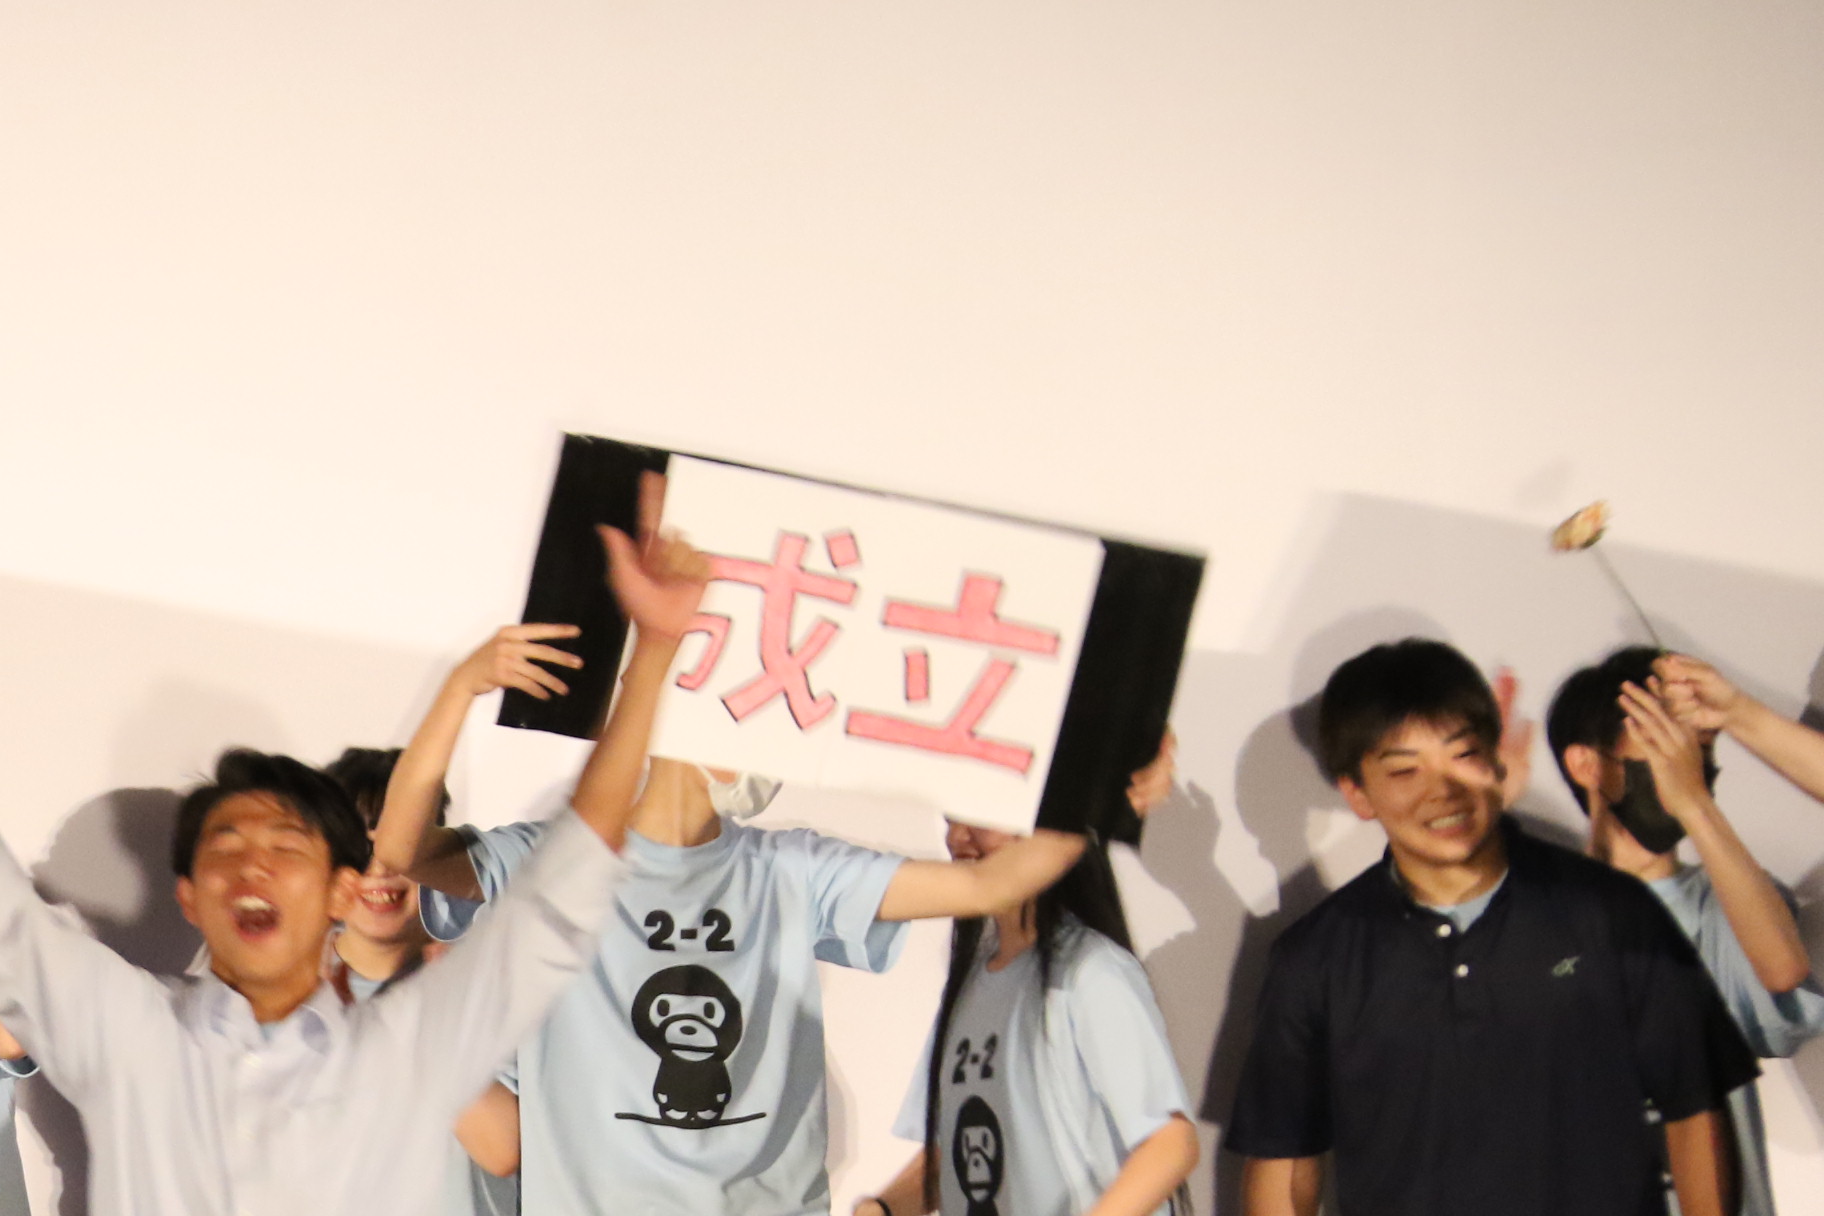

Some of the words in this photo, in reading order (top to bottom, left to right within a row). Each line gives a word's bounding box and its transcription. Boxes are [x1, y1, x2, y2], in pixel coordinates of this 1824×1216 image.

[676, 529, 1061, 775] 成立
[643, 908, 735, 952] 2-2
[952, 1034, 998, 1085] 2-2
